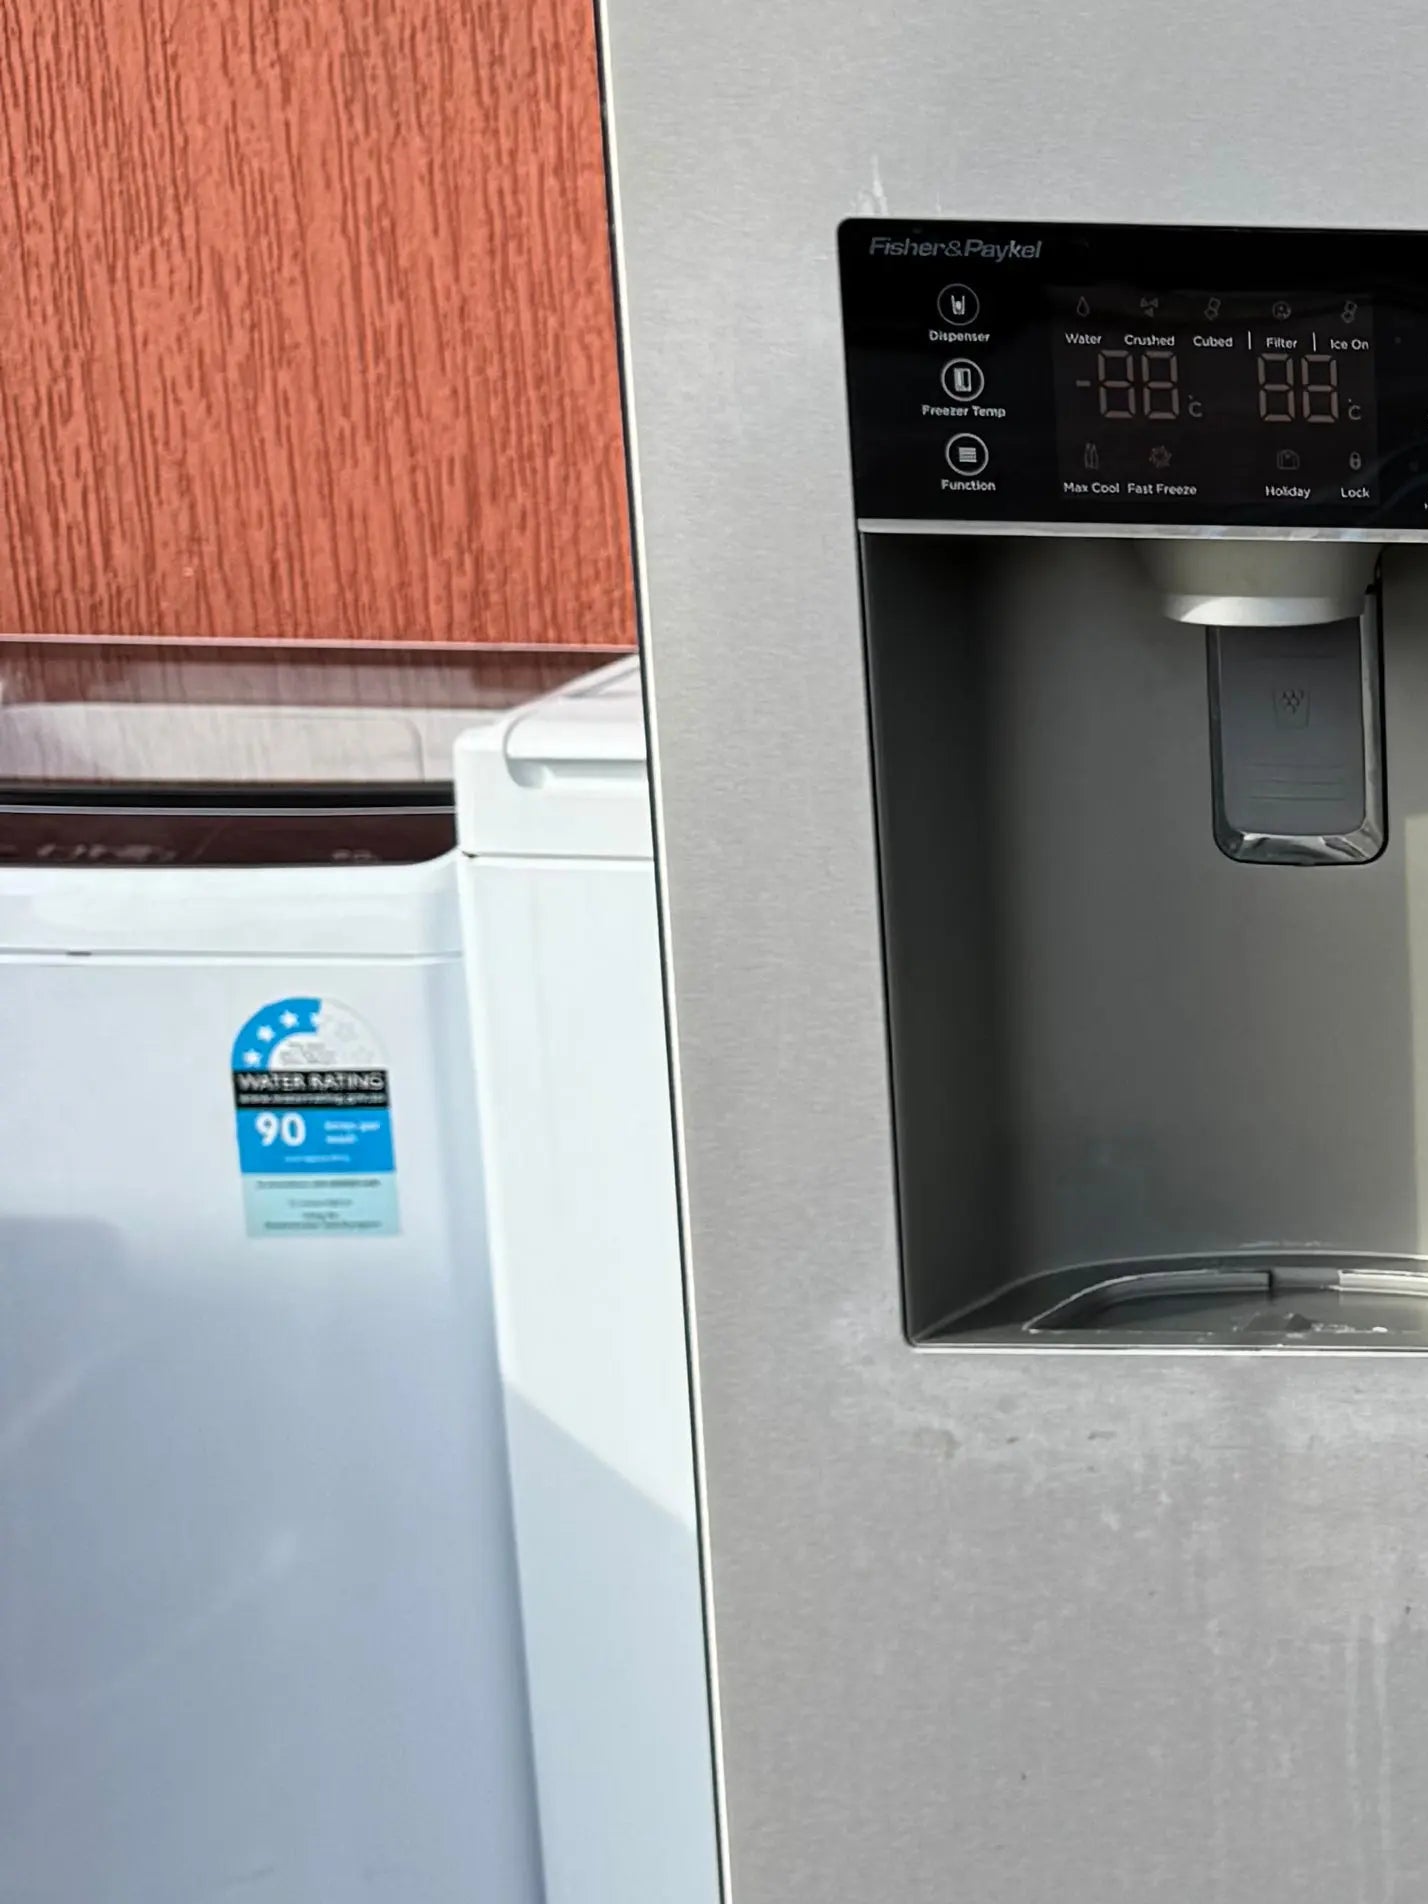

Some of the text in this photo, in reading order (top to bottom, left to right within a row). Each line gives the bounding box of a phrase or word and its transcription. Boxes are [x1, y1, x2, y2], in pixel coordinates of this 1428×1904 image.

[869, 236, 1043, 263] Fisher&Paykel
[928, 329, 990, 342] Dispenser
[1065, 332, 1233, 347] Water Crushed Cubed
[1266, 337, 1298, 349] Filter
[1330, 339, 1369, 350] Ice On
[921, 404, 1006, 417] Freezer Temp
[941, 479, 996, 491] Function
[1063, 482, 1120, 493] Max Cool
[1127, 483, 1197, 495] Fast Freeze
[1265, 485, 1311, 499] Holiday
[1341, 487, 1370, 498] Lock
[238, 1072, 385, 1091] WATER RATING
[255, 1111, 307, 1147] 90
